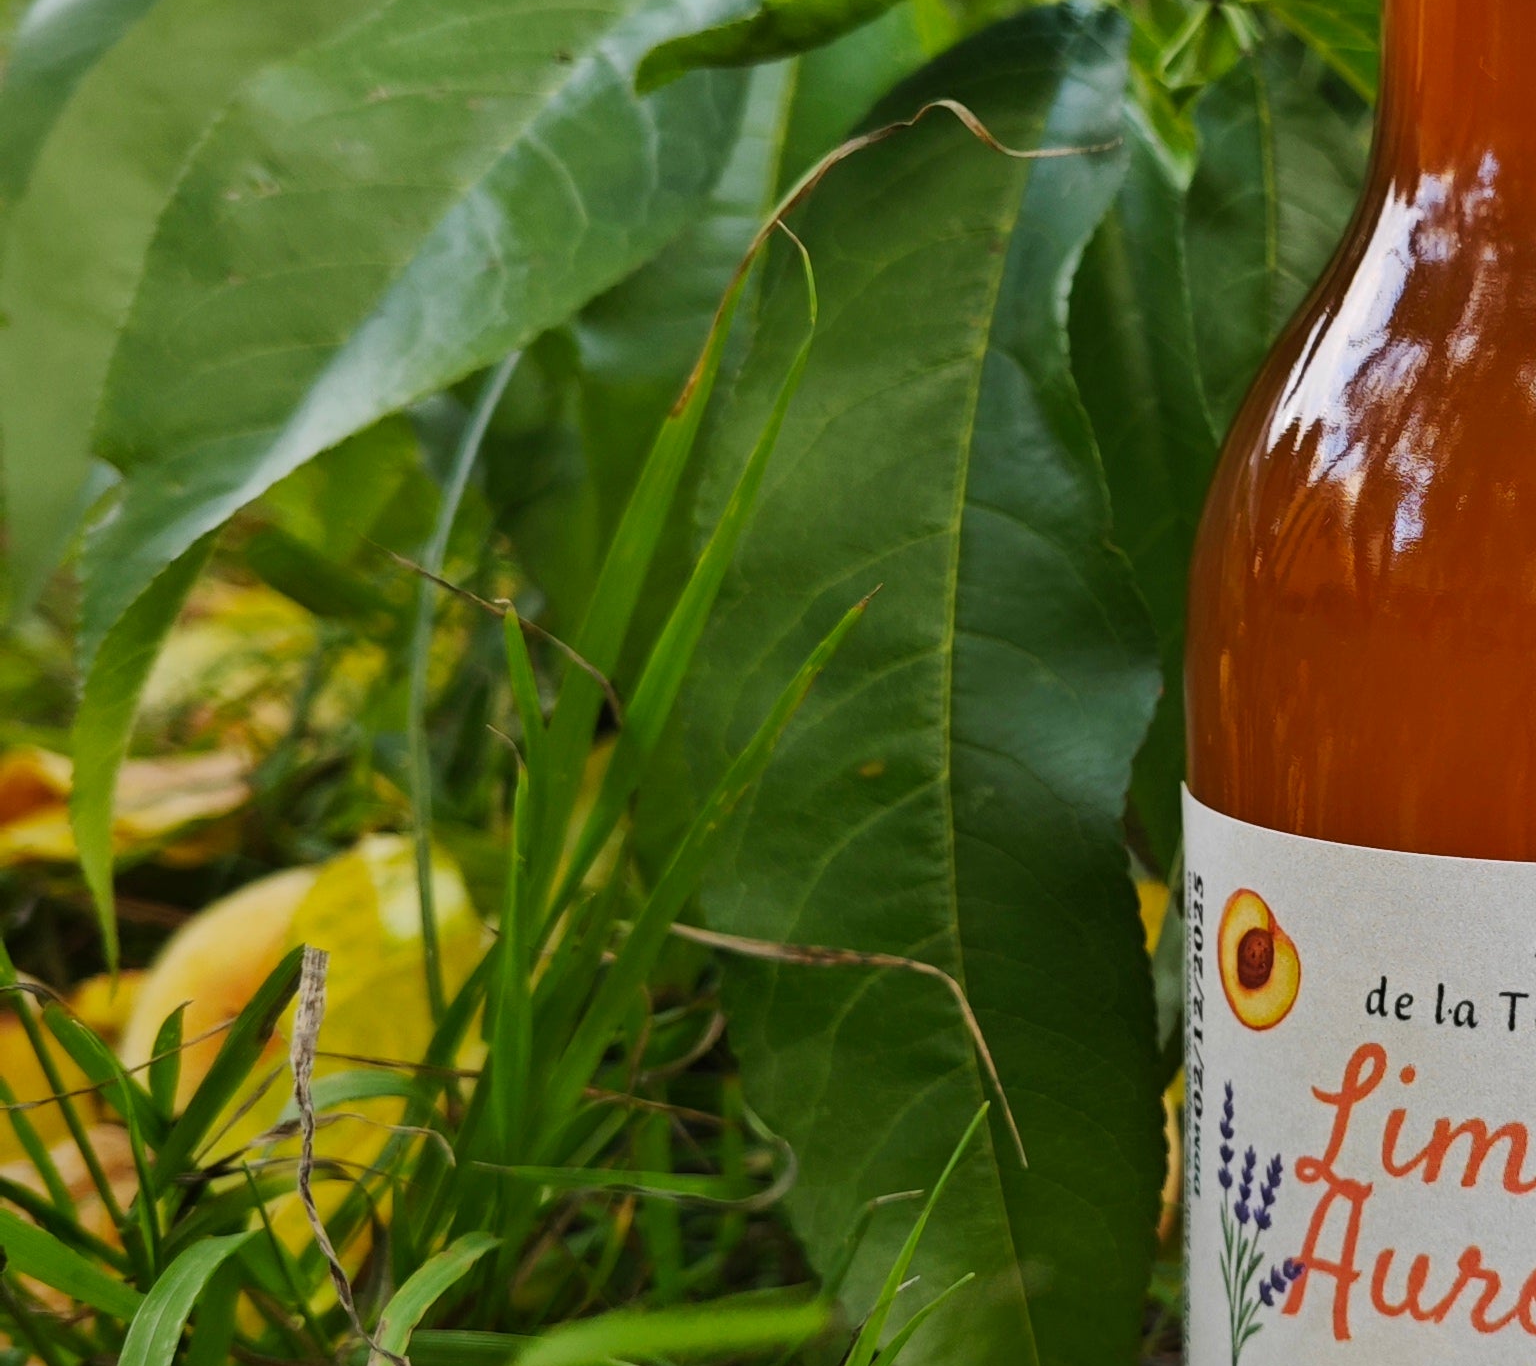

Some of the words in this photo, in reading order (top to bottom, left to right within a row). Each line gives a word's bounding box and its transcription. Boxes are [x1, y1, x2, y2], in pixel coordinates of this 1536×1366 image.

[1193, 873, 1205, 1119] 02/12/2025
[1365, 976, 1414, 1021] de
[1435, 984, 1478, 1028] la
